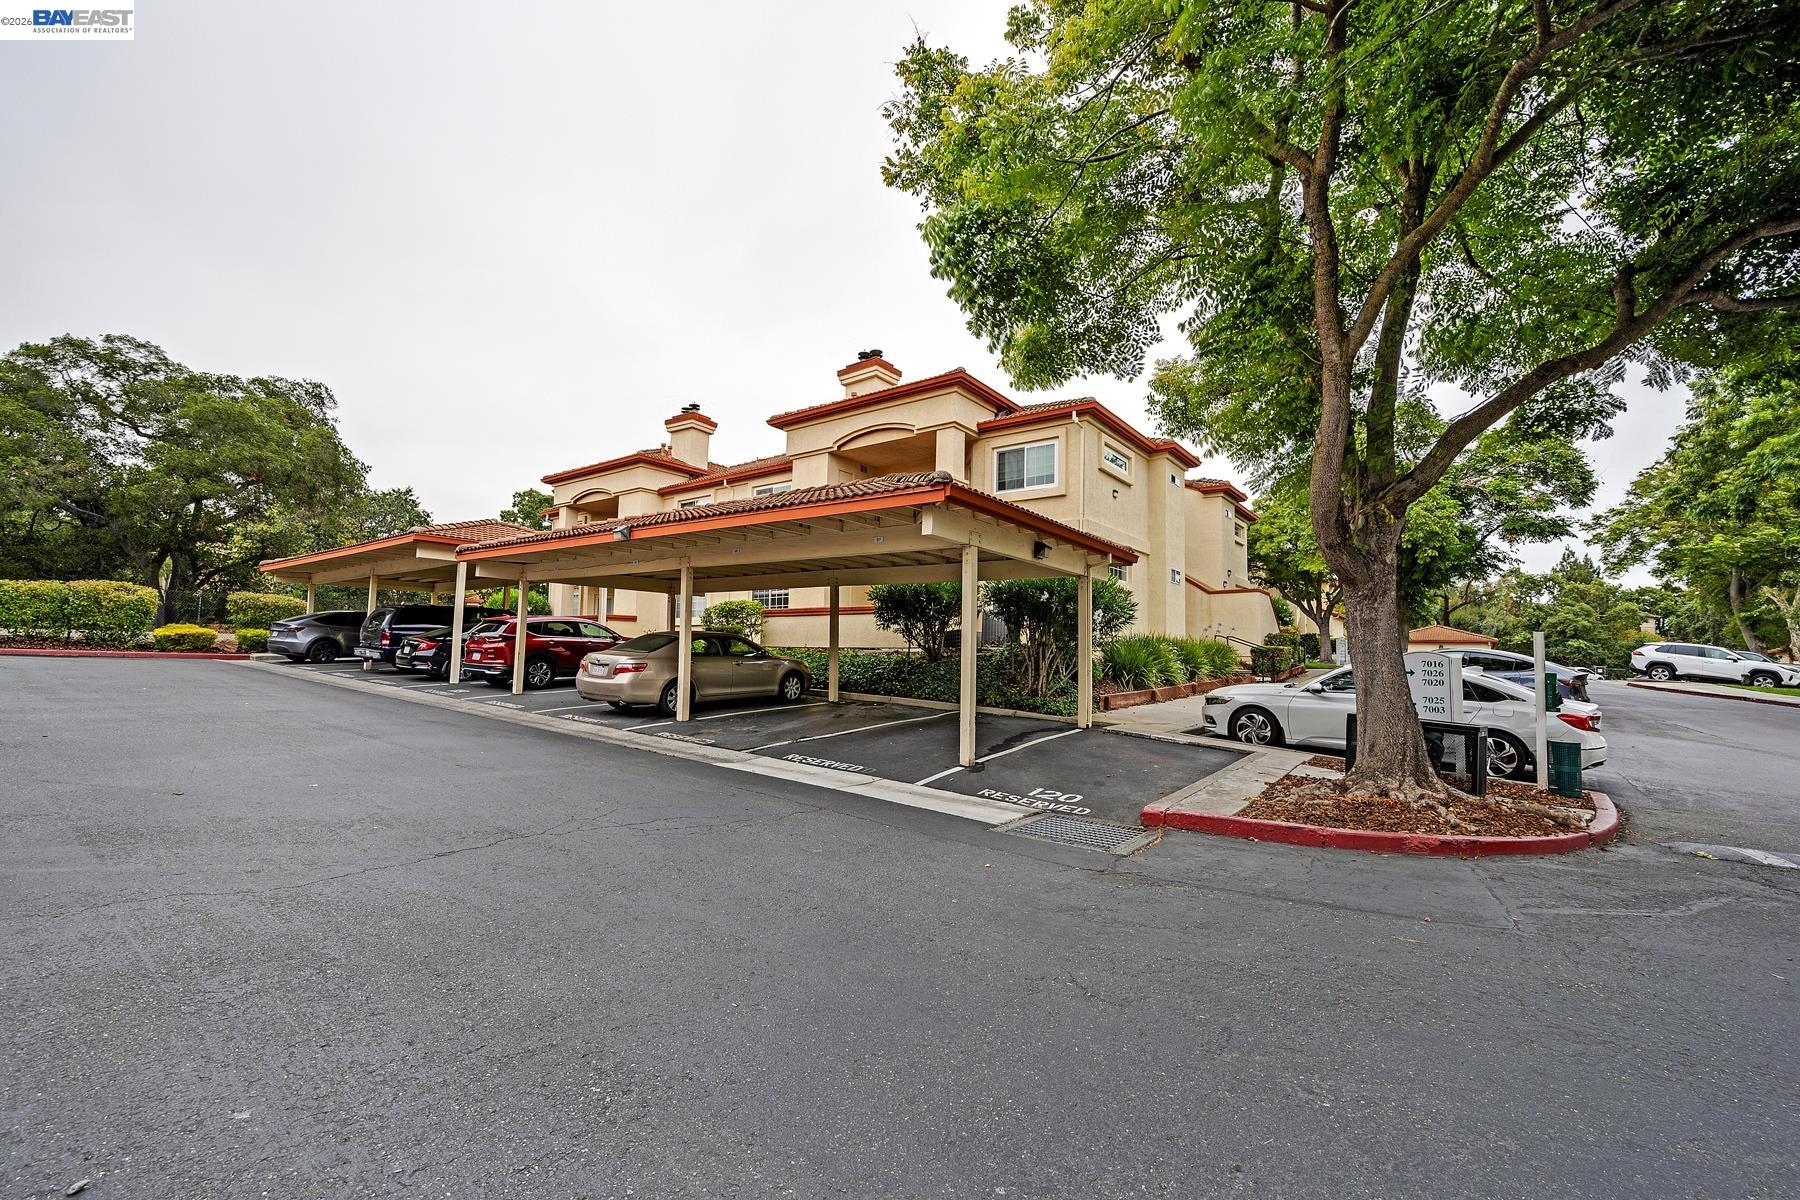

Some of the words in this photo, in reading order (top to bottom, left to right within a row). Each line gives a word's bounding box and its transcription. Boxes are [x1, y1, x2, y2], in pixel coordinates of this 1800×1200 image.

[1422, 679, 1445, 687] 7020
[1423, 706, 1446, 714] 7003
[782, 753, 864, 772] RESERVED
[977, 788, 1091, 815] RESERVED
[1027, 788, 1084, 803] 120
